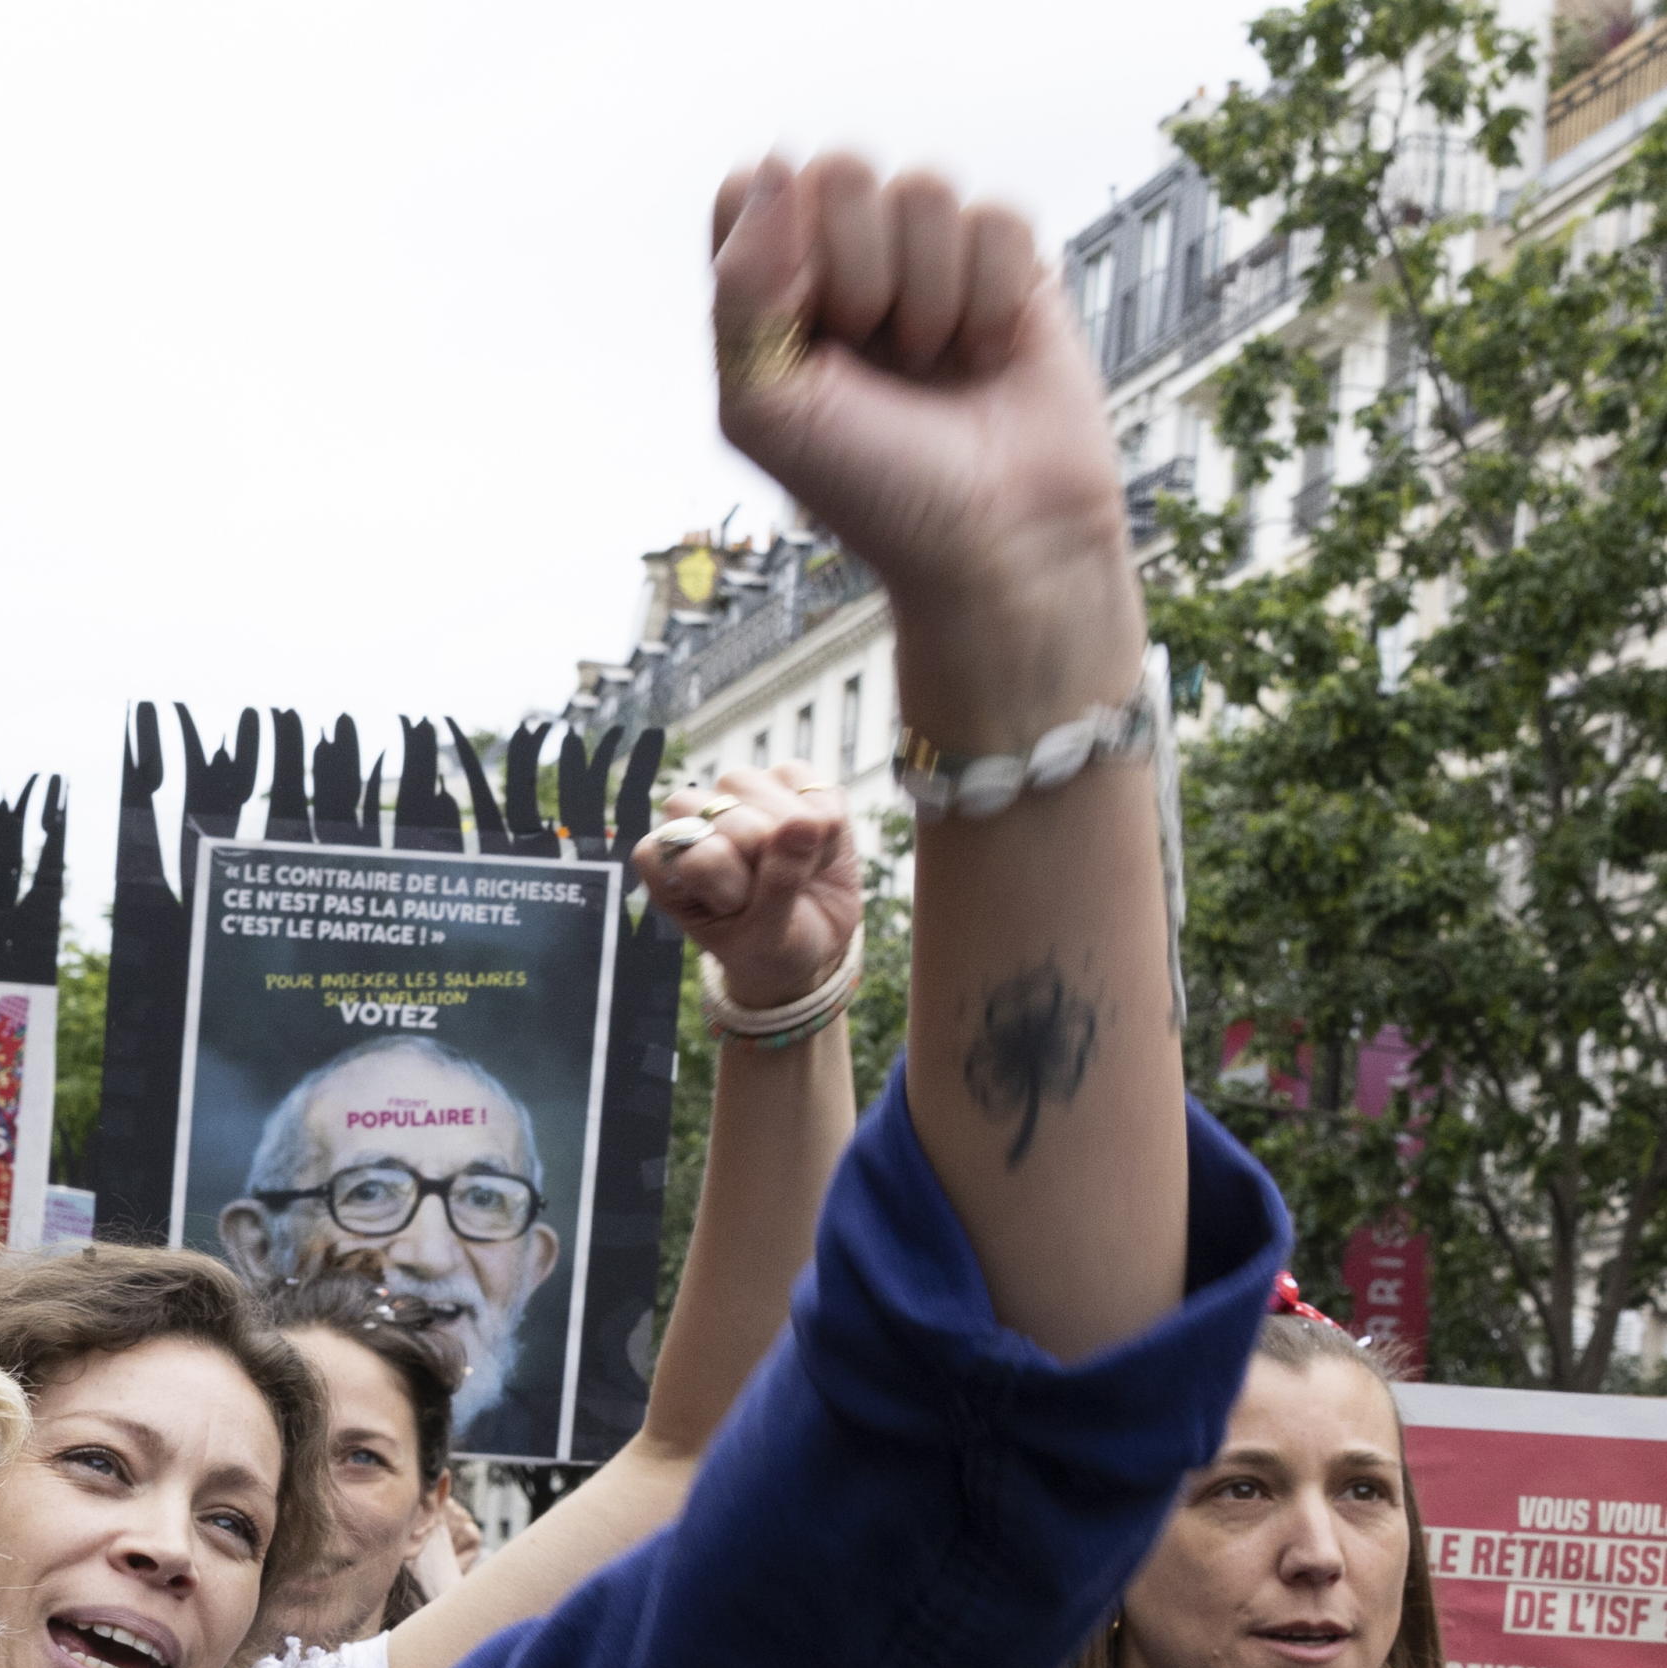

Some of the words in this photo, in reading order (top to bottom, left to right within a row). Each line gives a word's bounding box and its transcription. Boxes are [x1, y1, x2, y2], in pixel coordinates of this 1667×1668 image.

[244, 863, 271, 884] LE
[274, 865, 403, 893] CONTRAIRE
[406, 873, 438, 895] DE
[441, 876, 468, 898] LA
[474, 878, 586, 906] RICHESSE,
[223, 888, 253, 910] CE
[256, 890, 320, 913] N'EST
[323, 894, 365, 916] PAS
[368, 897, 398, 918] LA
[403, 900, 521, 926] PAUVRETÉ.
[221, 914, 283, 936] C'EST
[286, 918, 314, 939] LE
[318, 920, 416, 946] PARTAGE
[420, 927, 427, 946] !
[265, 973, 315, 990] POUR
[320, 972, 398, 989] INDEXER
[405, 972, 438, 988] LES
[444, 971, 527, 987] SALAIRES
[339, 1001, 438, 1029] VOTEZ
[346, 1108, 475, 1129] POPULAIRE
[1518, 1495, 1590, 1531] VOUS
[1597, 1500, 1667, 1537] VOUL
[1470, 1531, 1667, 1588] RÉTABLISS
[1512, 1590, 1557, 1631] DE
[1567, 1593, 1650, 1636] L'ISF
